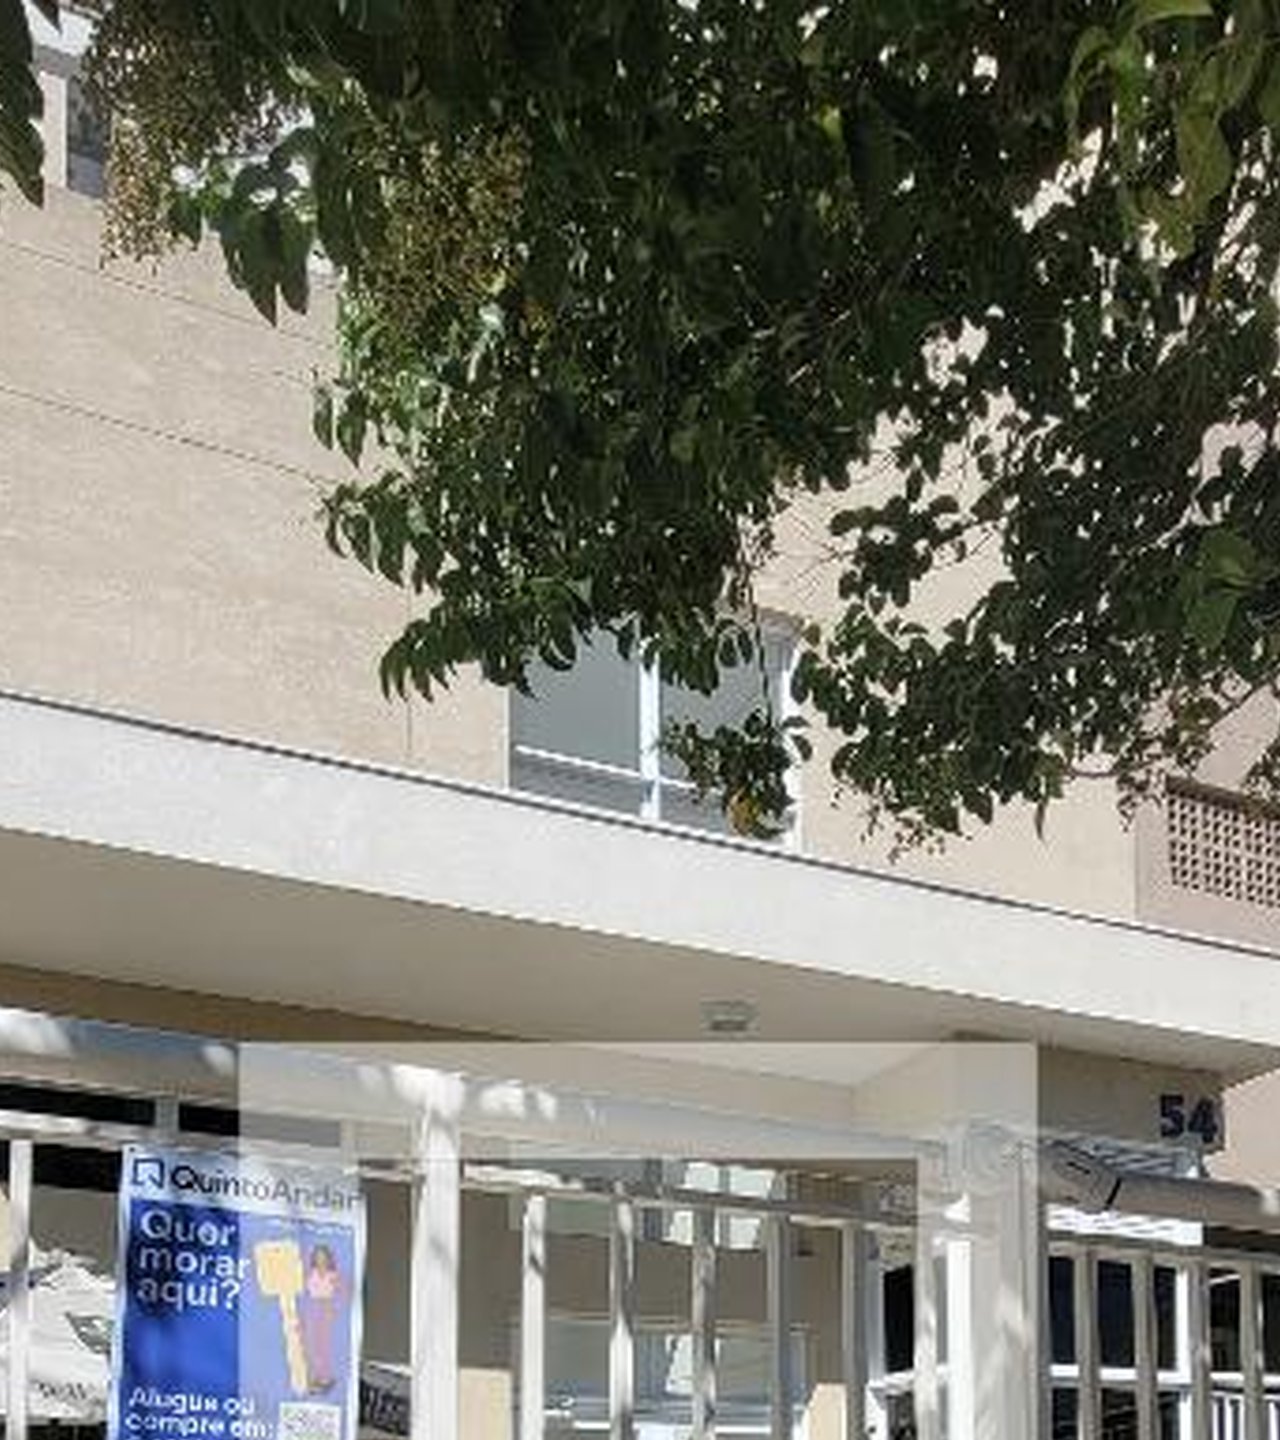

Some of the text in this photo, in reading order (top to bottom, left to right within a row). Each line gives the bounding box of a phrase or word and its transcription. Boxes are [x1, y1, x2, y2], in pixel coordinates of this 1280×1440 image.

[1160, 1095, 1218, 1143] 54
[172, 1165, 361, 1209] QuintoAndar
[141, 1209, 236, 1246] Quer
[139, 1247, 250, 1279] morar
[137, 1276, 240, 1311] aqui?
[223, 1397, 255, 1416] ou
[125, 1413, 224, 1437] compre
